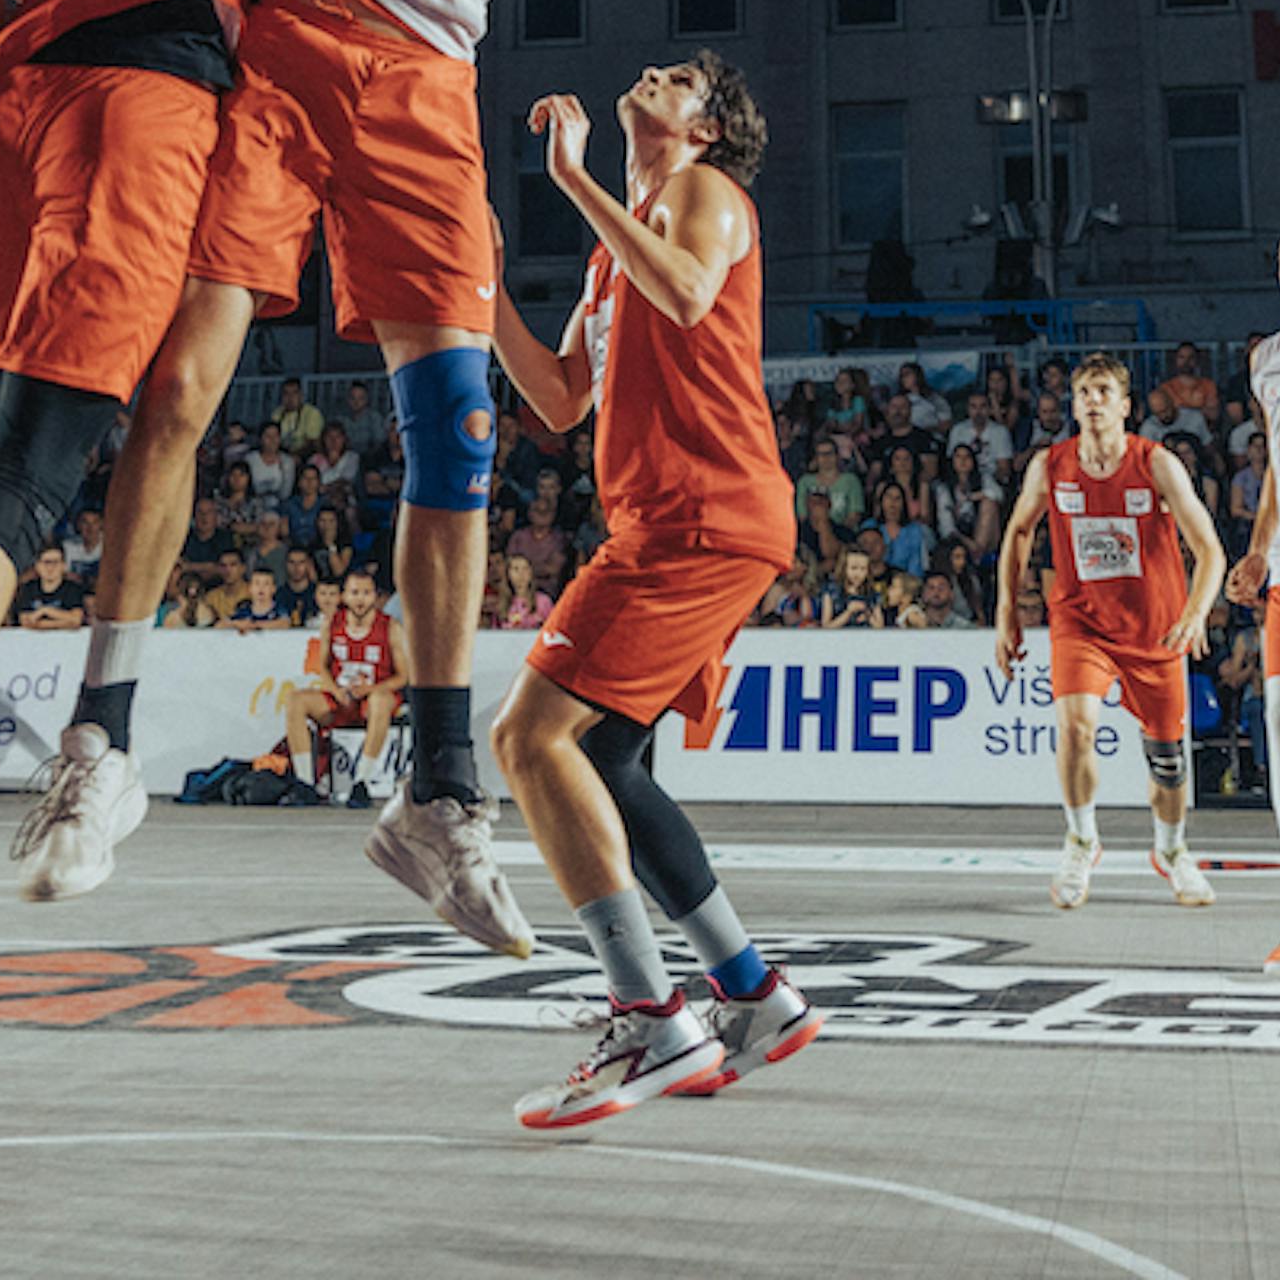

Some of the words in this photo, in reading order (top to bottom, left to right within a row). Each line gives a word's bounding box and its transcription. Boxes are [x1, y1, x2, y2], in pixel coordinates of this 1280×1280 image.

[7, 664, 62, 703] od
[983, 663, 1054, 707] Viš
[782, 665, 967, 753] HEP
[984, 716, 1120, 756] stre
